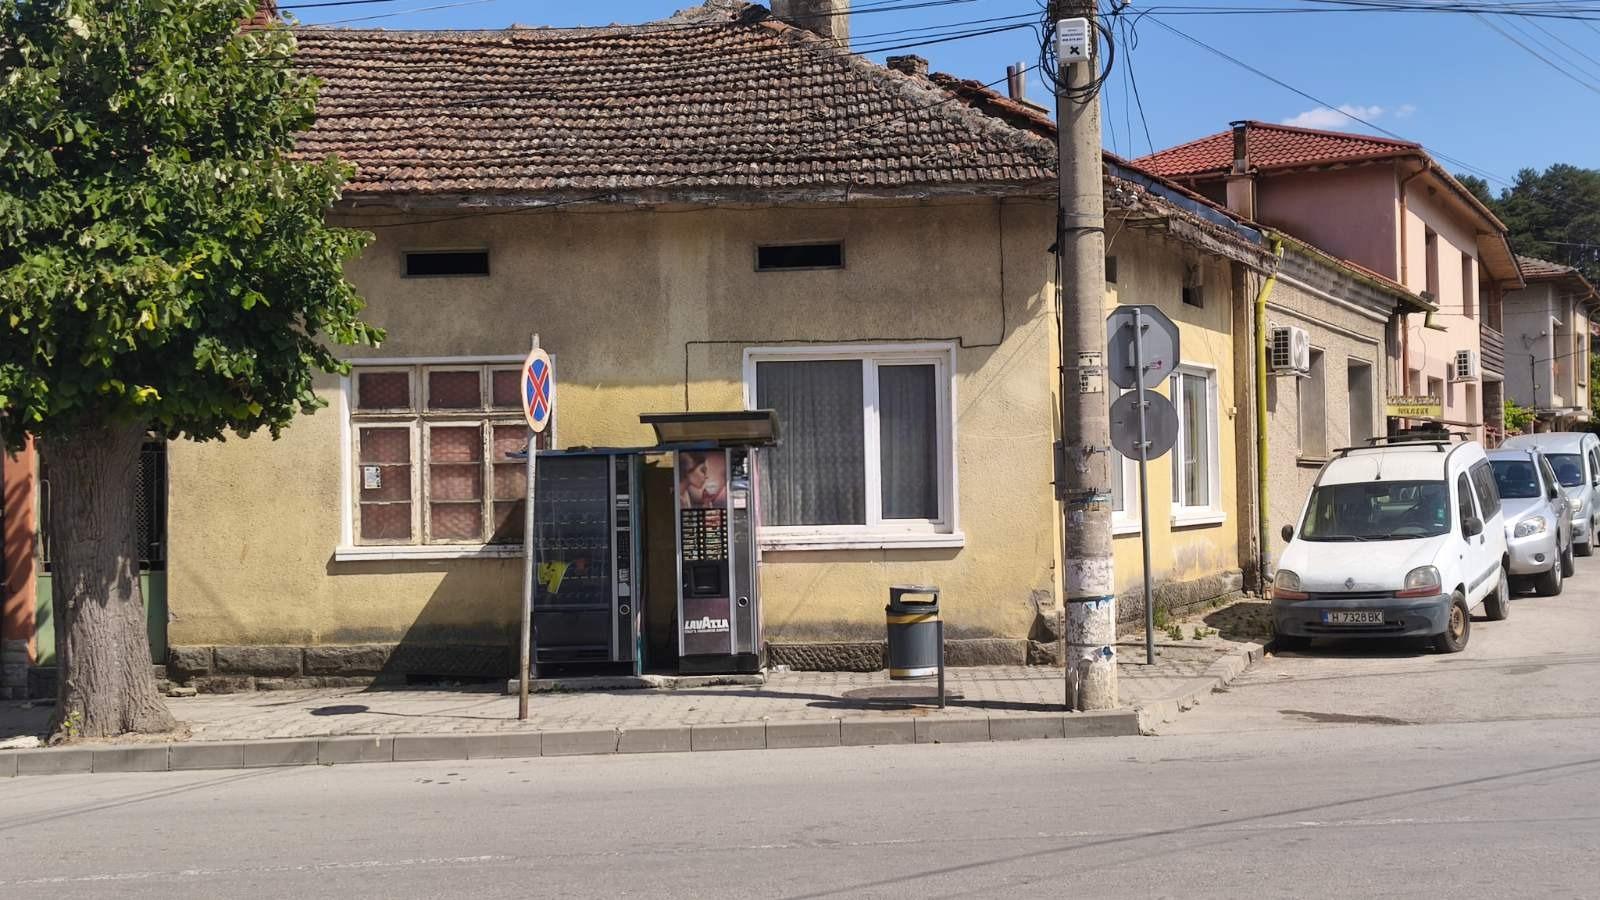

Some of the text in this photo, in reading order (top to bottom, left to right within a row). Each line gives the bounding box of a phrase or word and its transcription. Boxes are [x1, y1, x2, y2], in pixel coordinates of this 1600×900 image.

[684, 616, 729, 629] LAVAZZA
[1332, 612, 1381, 622] H 7328 BK
